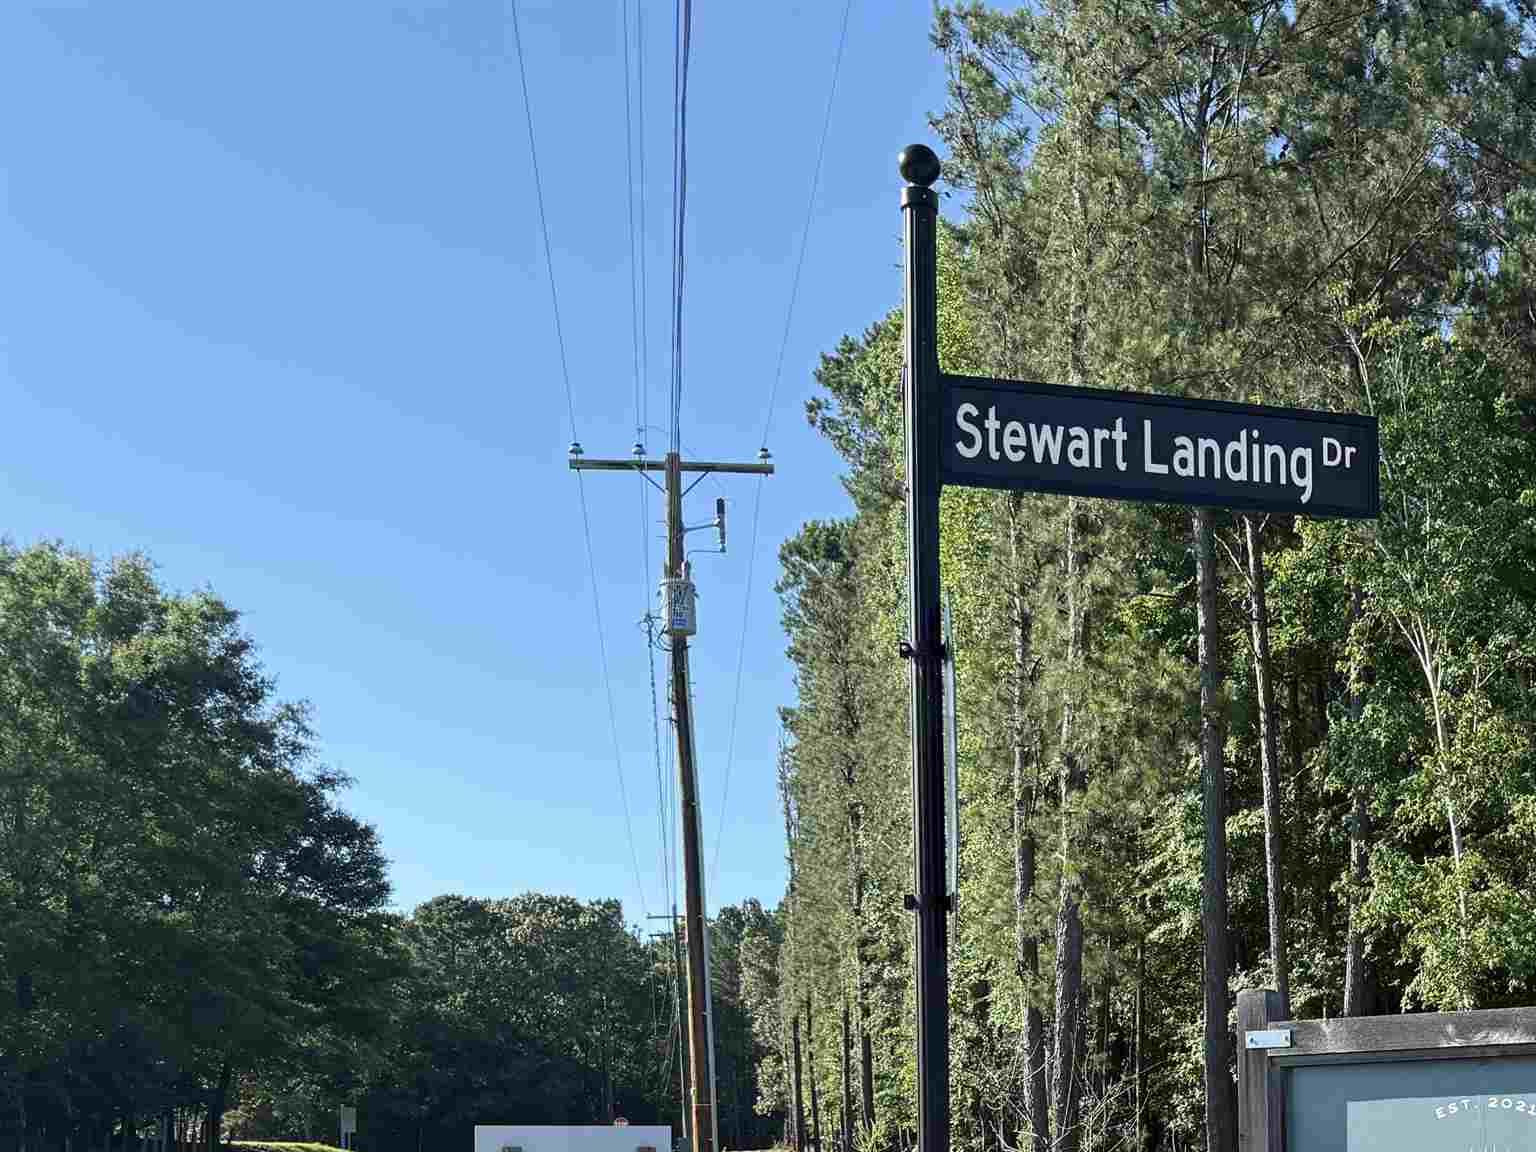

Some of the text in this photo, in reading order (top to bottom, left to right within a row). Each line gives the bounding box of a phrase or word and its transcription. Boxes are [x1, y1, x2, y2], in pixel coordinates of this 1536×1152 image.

[955, 402, 1357, 503] Stewart Landing Dr
[1434, 1097, 1536, 1119] EST. 2021
